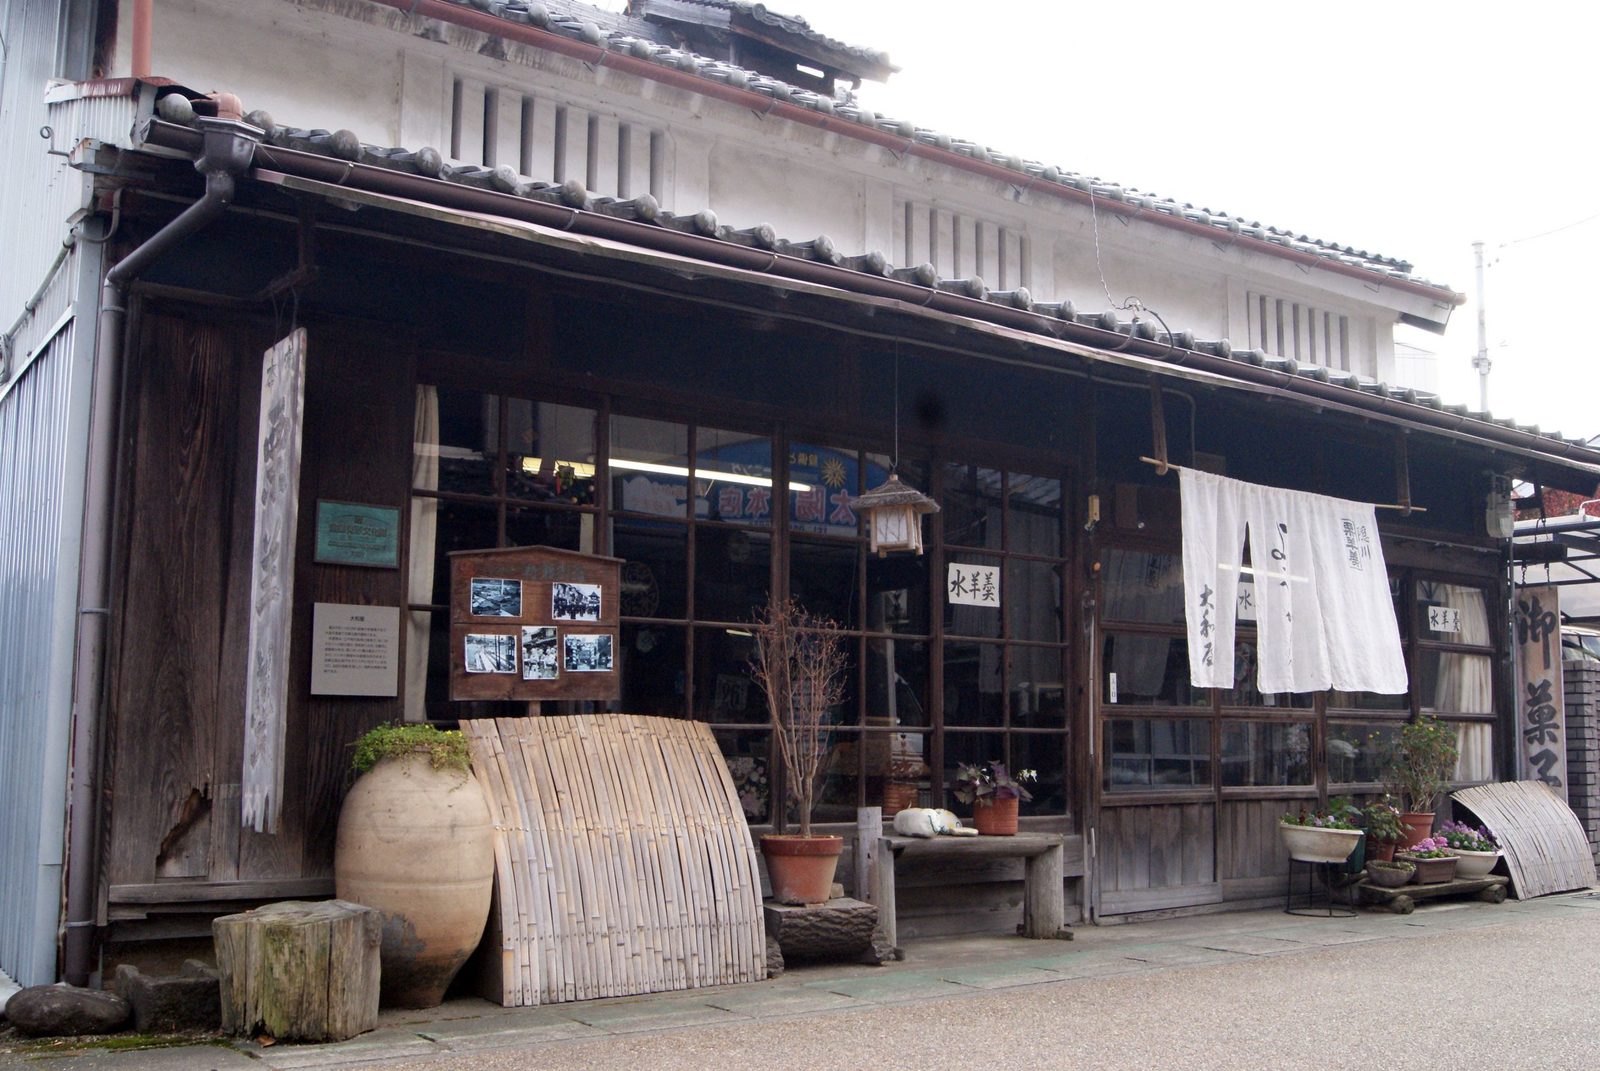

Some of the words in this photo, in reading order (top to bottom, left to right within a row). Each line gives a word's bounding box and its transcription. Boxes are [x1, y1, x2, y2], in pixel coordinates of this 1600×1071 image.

[950, 569, 996, 602] 水羊羹
[1239, 589, 1254, 610] 水
[1199, 583, 1215, 667] 大和屋
[1430, 609, 1460, 632] 水羊羹
[1517, 595, 1562, 788] 御菓子
